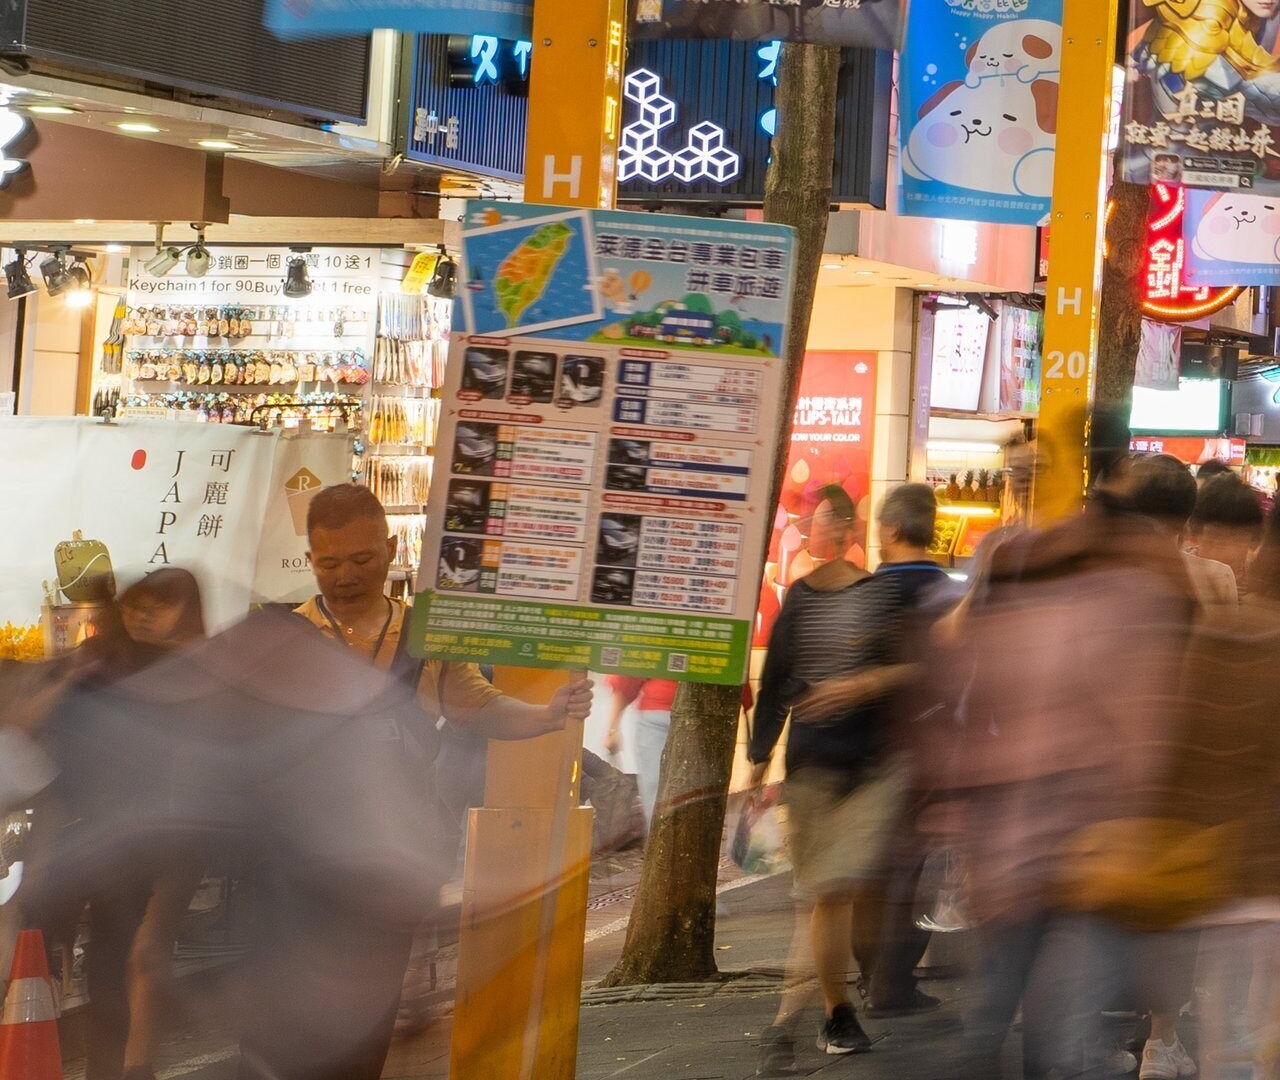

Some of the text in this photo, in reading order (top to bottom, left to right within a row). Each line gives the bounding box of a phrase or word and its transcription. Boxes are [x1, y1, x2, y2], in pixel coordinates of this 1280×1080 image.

[951, 8, 970, 18] Happy
[973, 11, 994, 19] Happy
[543, 155, 582, 199] H
[345, 254, 361, 269] 送
[130, 279, 196, 293] Keychain
[208, 279, 230, 291] for
[342, 282, 372, 295] free
[1057, 287, 1081, 315] H
[1045, 351, 1086, 379] 20
[196, 448, 236, 539] 可麗餅
[298, 475, 311, 491] R
[148, 450, 186, 570] JAPA
